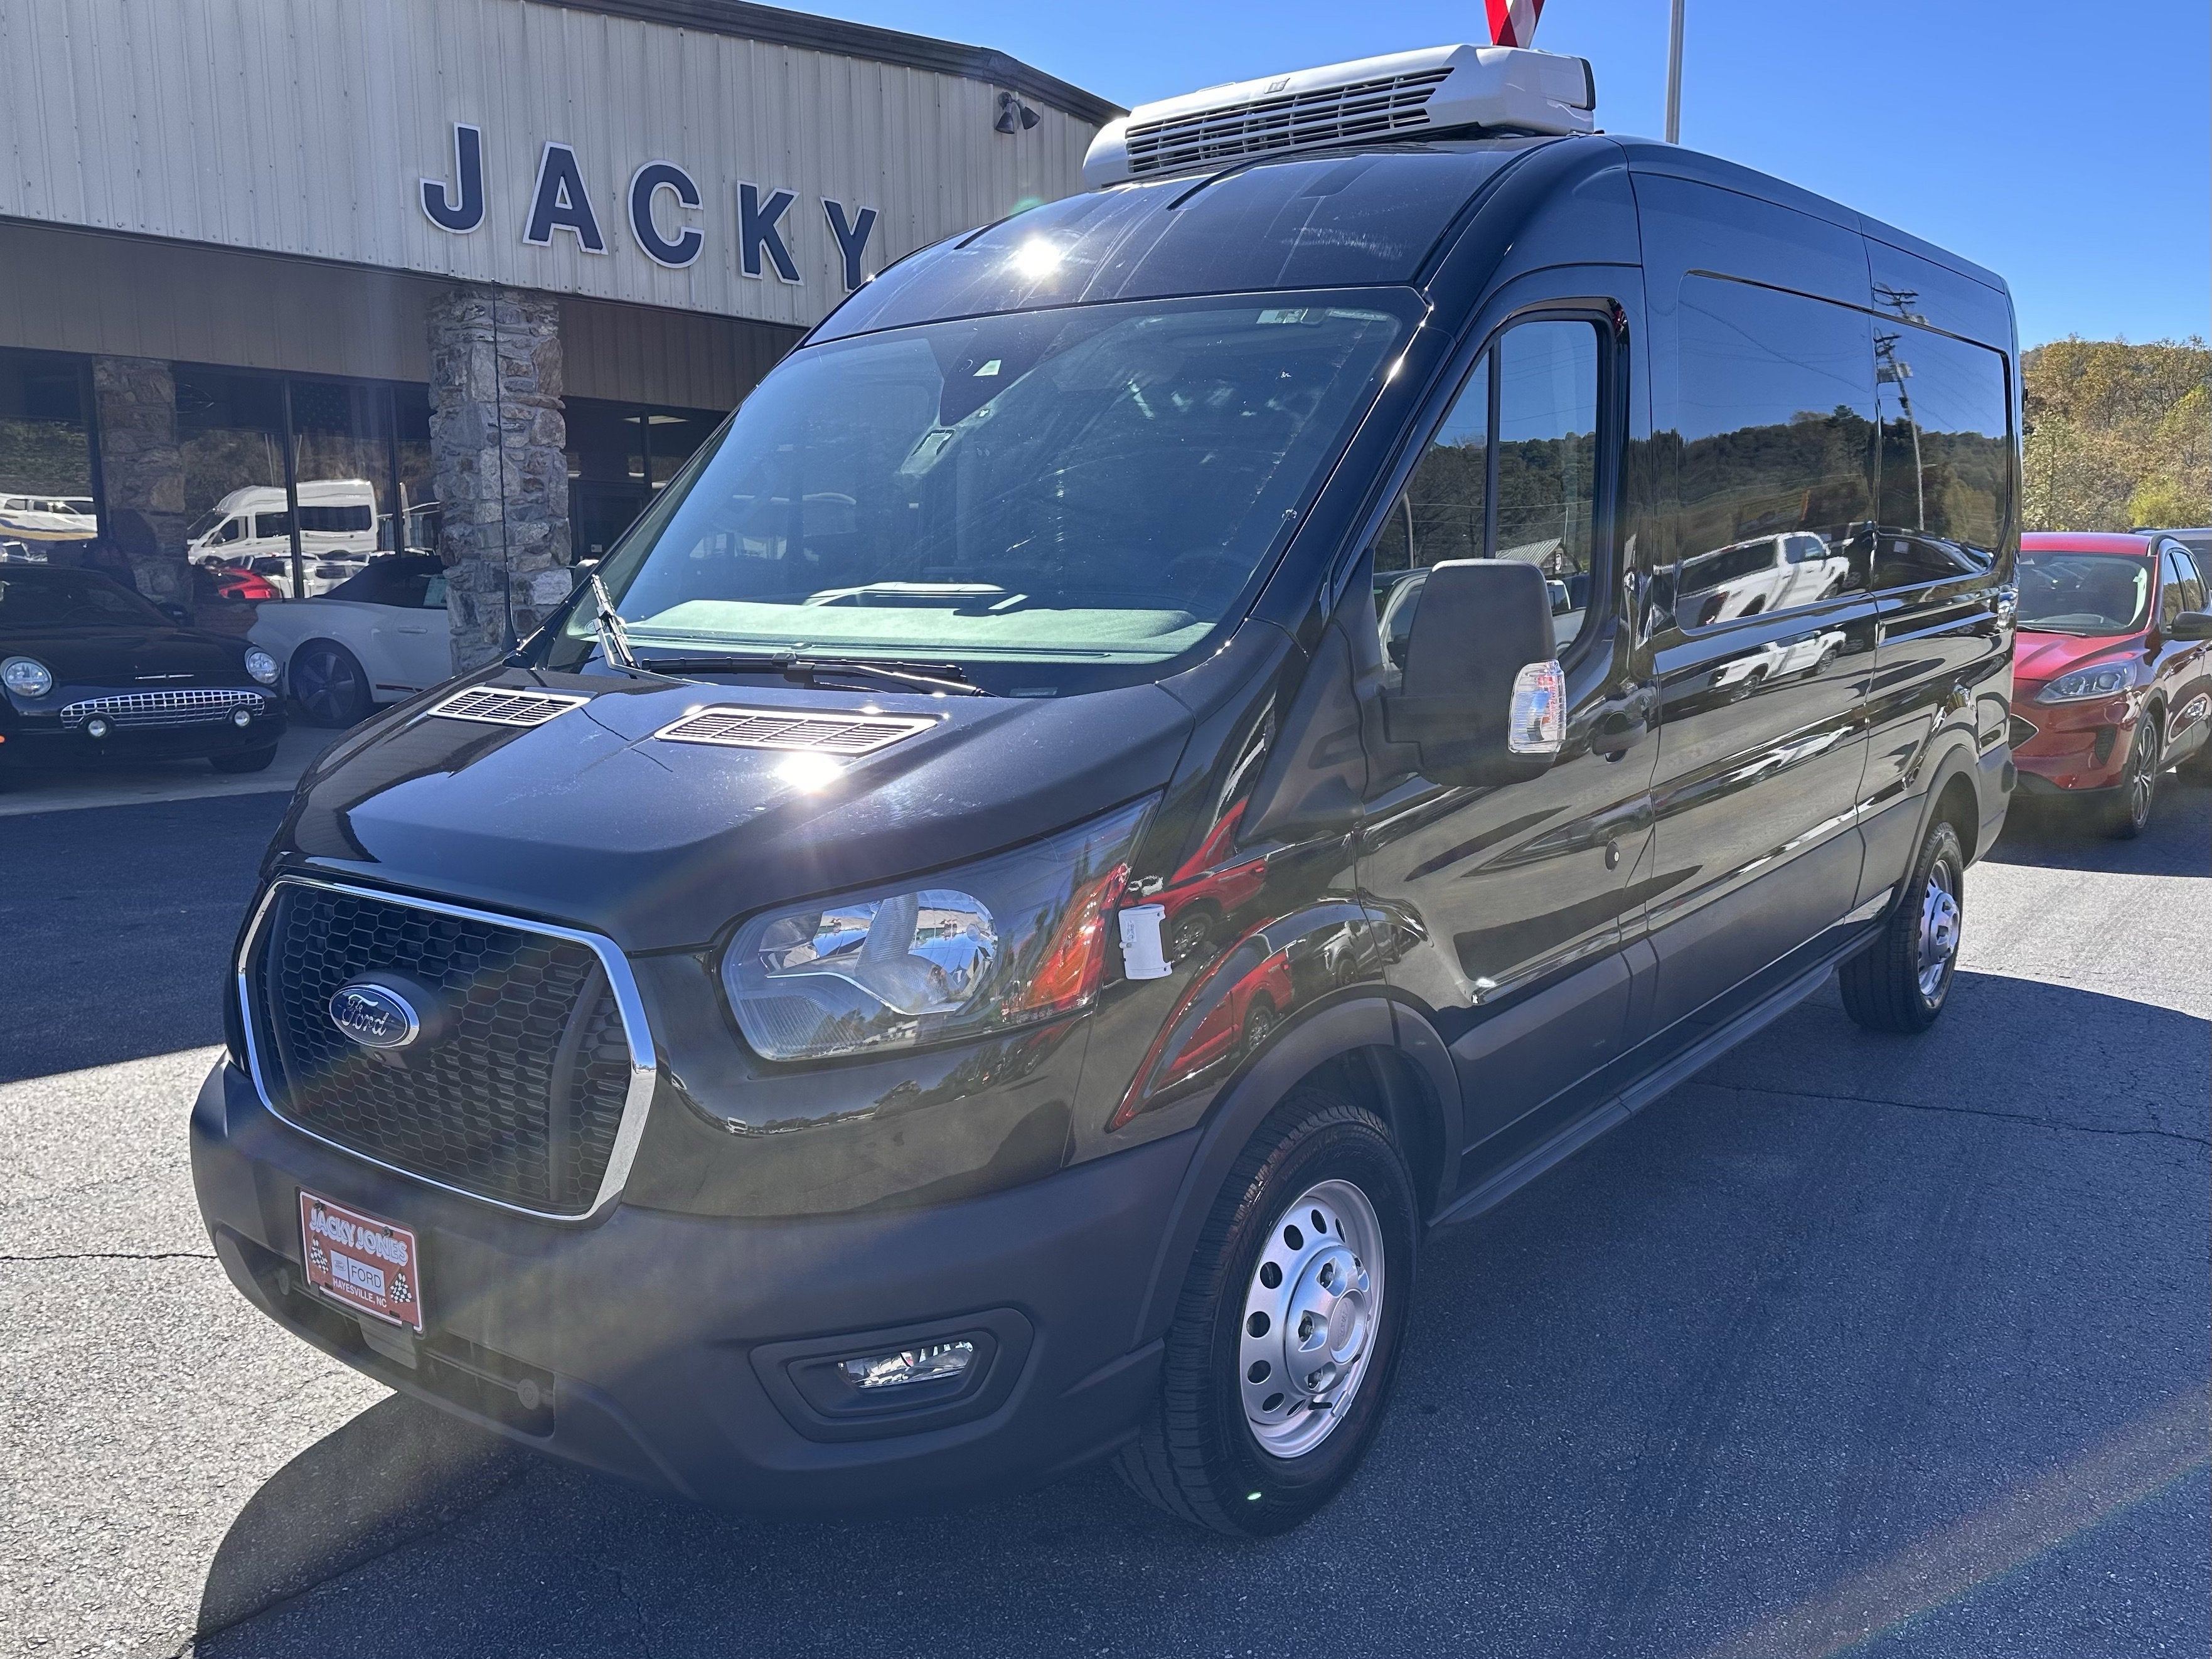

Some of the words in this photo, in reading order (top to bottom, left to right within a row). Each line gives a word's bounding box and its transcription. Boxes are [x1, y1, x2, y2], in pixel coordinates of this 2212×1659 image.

[419, 122, 879, 292] JACKY
[341, 994, 390, 1036] Ford
[309, 1207, 356, 1247] JACKY
[356, 1227, 408, 1266] JONES
[333, 1278, 375, 1305] HAYESVILLE,
[376, 1294, 387, 1308] NC
[351, 1266, 382, 1288] FORD
